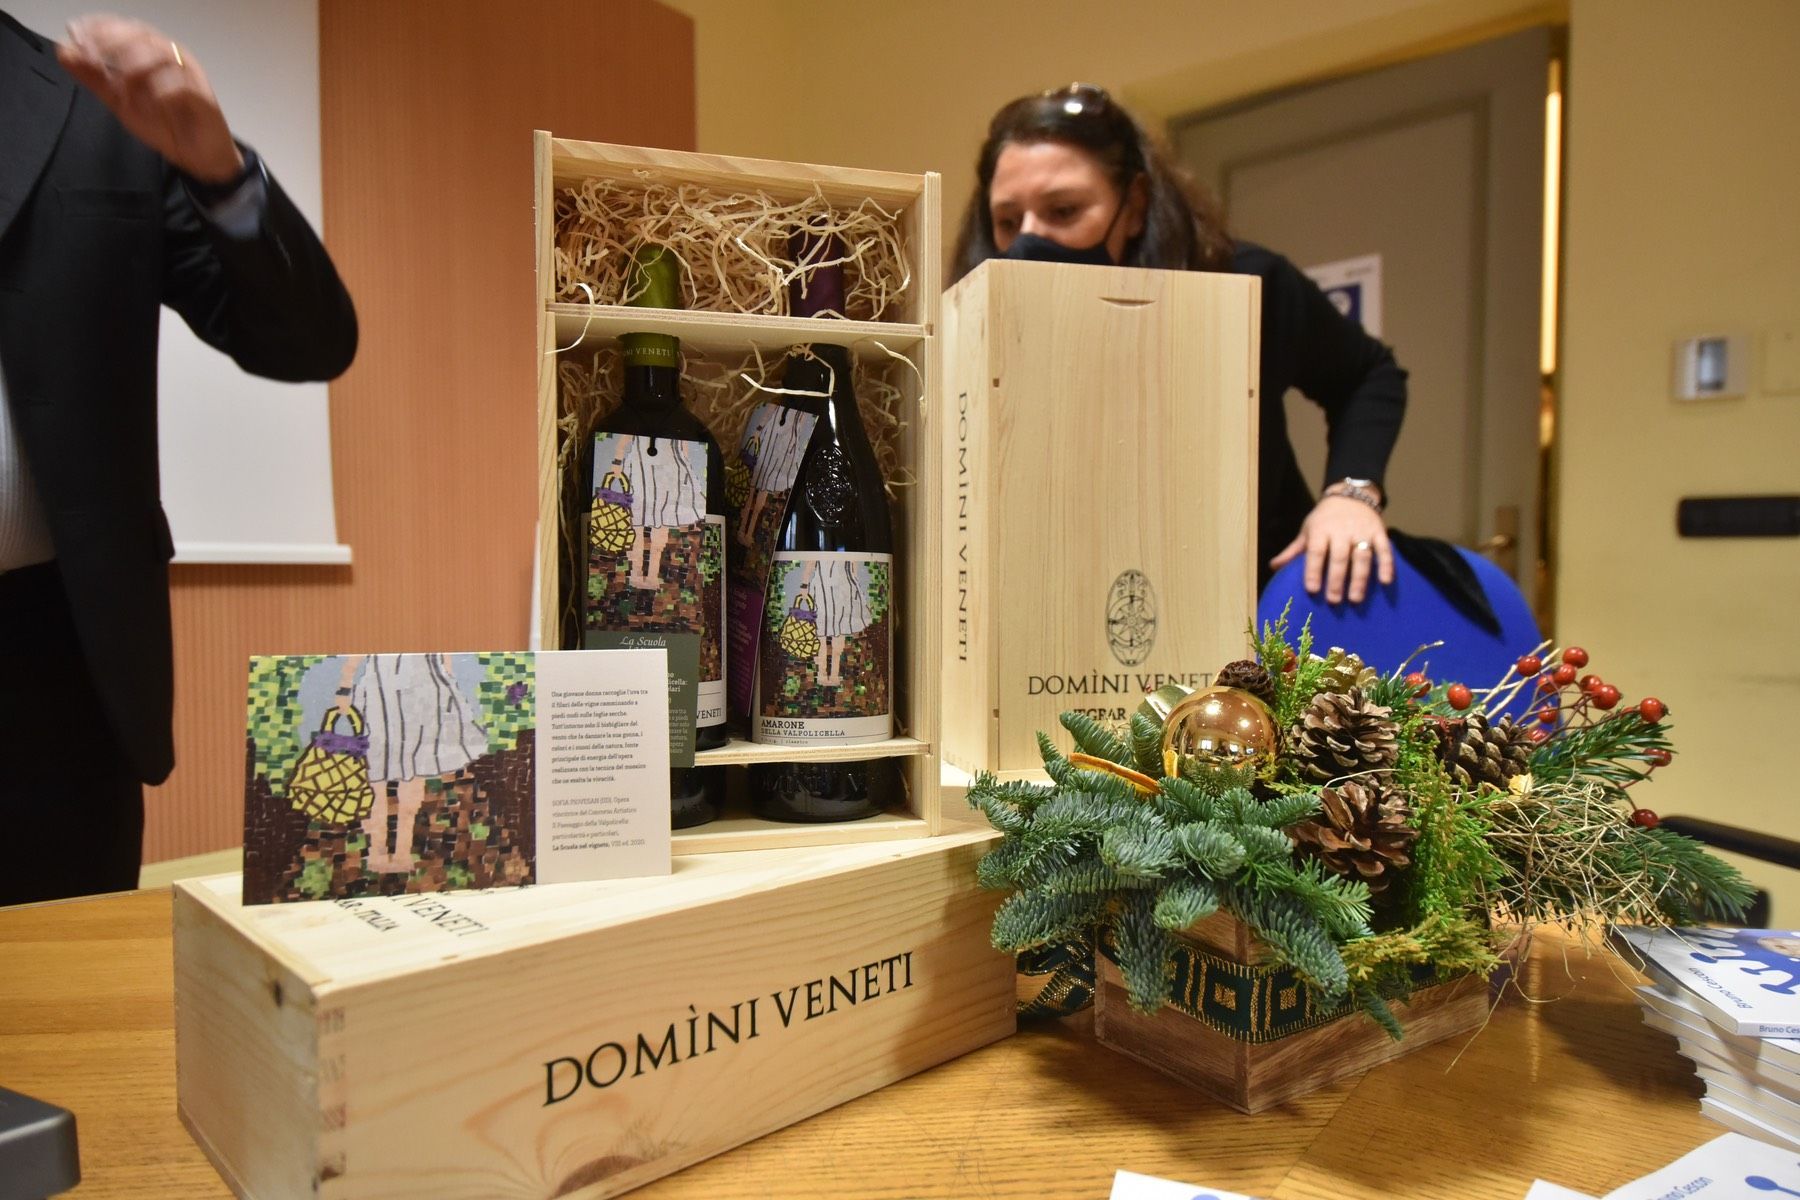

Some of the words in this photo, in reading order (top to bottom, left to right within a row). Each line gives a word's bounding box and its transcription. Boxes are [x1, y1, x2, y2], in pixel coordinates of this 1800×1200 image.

[635, 347, 671, 357] VENETI
[958, 544, 968, 662] VENETI
[619, 635, 635, 646] La
[637, 636, 667, 647] Scuola
[1028, 669, 1129, 695] DOMÌNI
[1136, 673, 1213, 693] VENET
[761, 719, 805, 729] AMARONE
[783, 729, 845, 737] VALPOLICELLA
[552, 755, 579, 763] principale
[542, 1004, 760, 1107] DOMÌNI
[770, 951, 914, 1028] VENETI
[1759, 1025, 1784, 1033] Bruno
[1786, 1026, 1800, 1034] Ces
